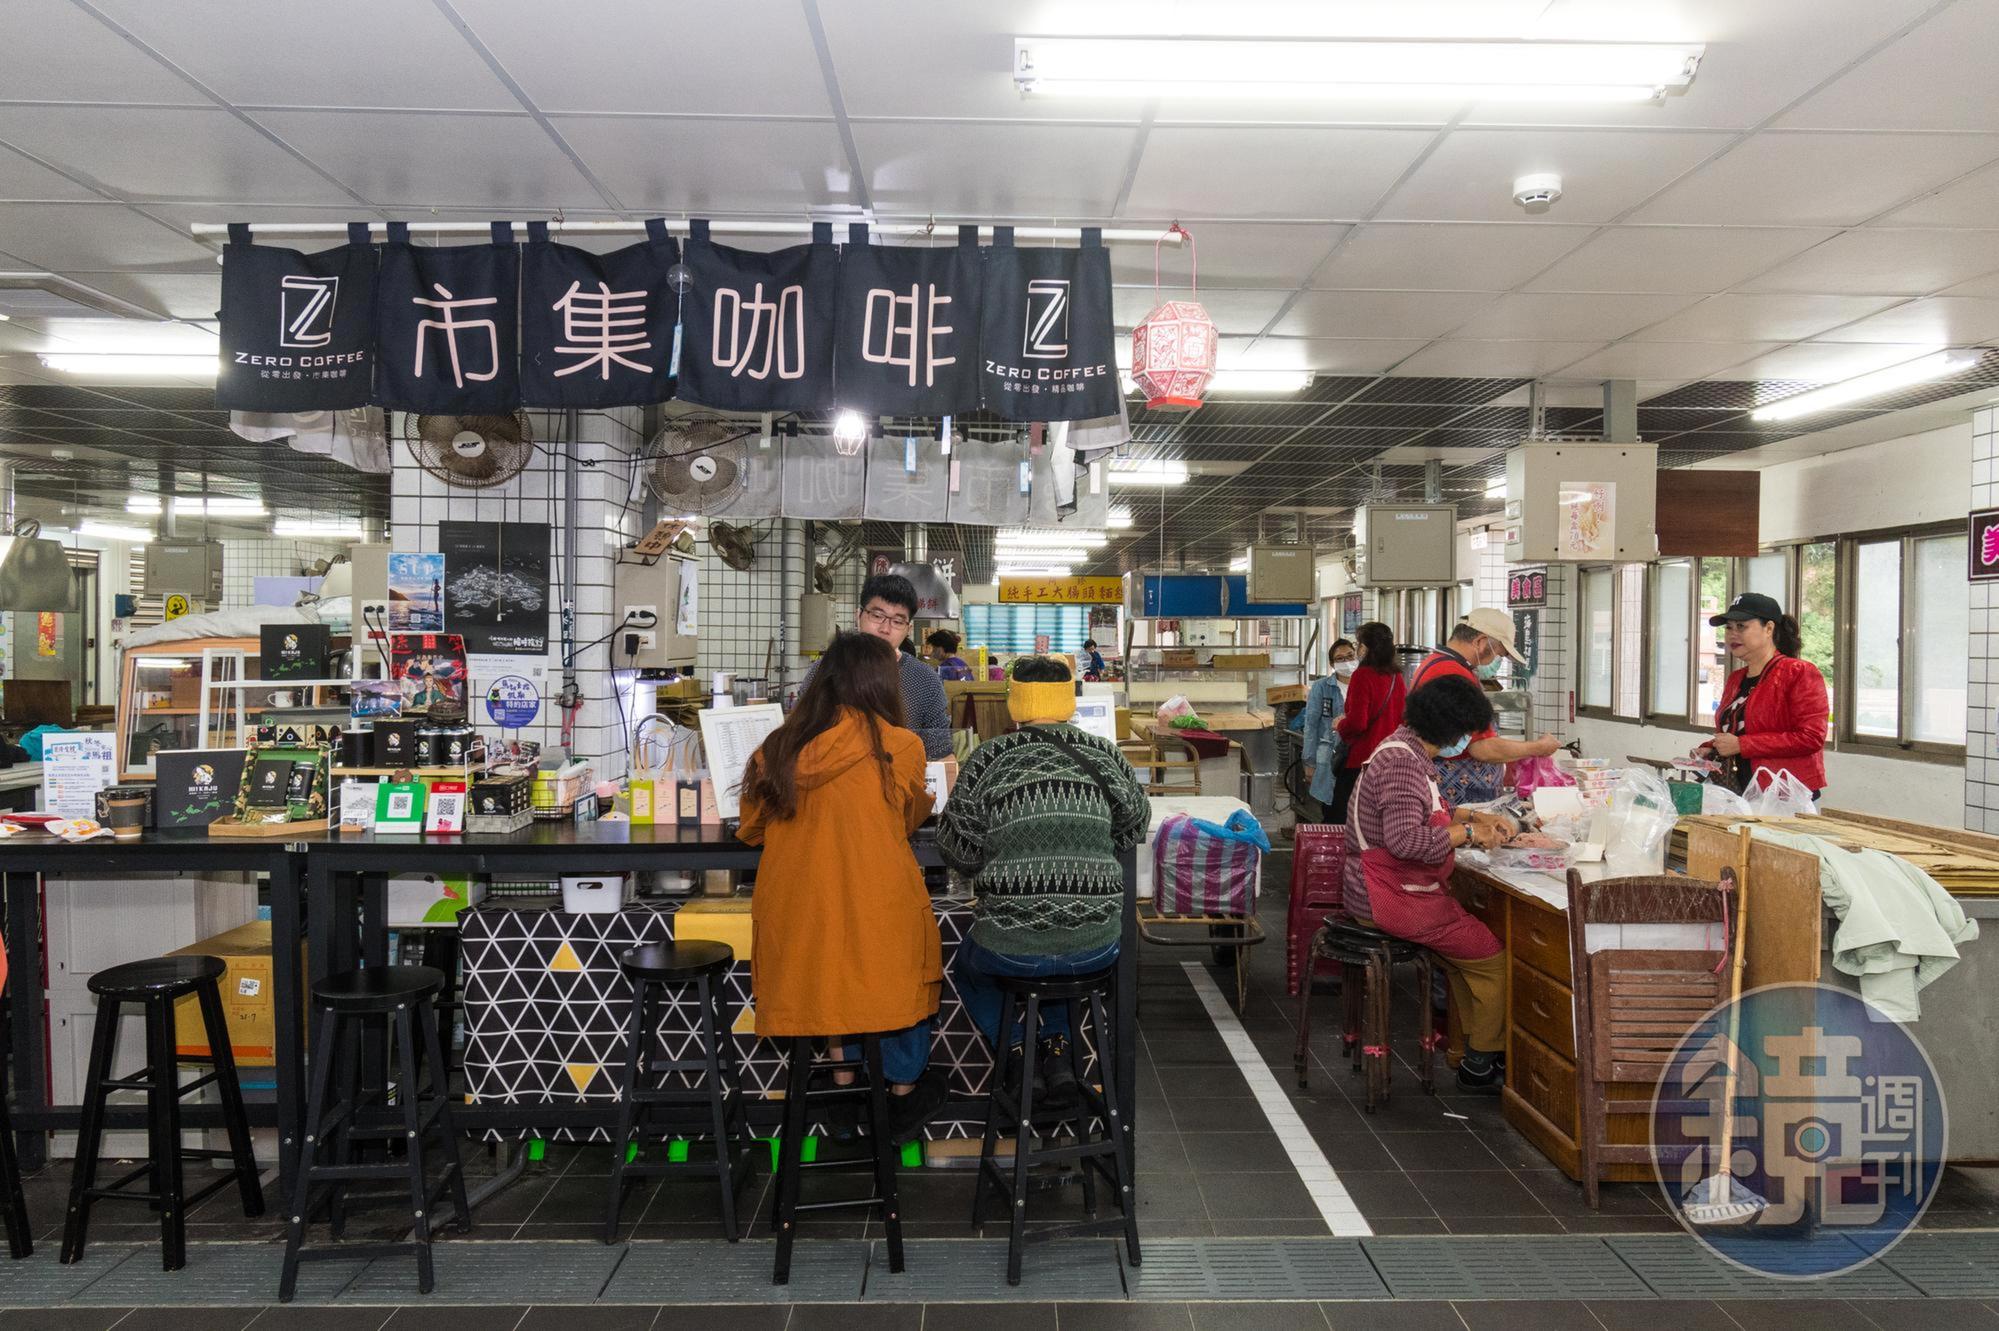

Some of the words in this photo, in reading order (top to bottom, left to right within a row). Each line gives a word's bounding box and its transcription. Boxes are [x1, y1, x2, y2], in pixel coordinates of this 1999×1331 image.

[413, 280, 956, 389] 市集咖啡
[234, 351, 293, 367] ZERO
[299, 350, 364, 368] COFFEE
[985, 359, 1032, 379] ZERO
[1037, 364, 1107, 381] COFFEE
